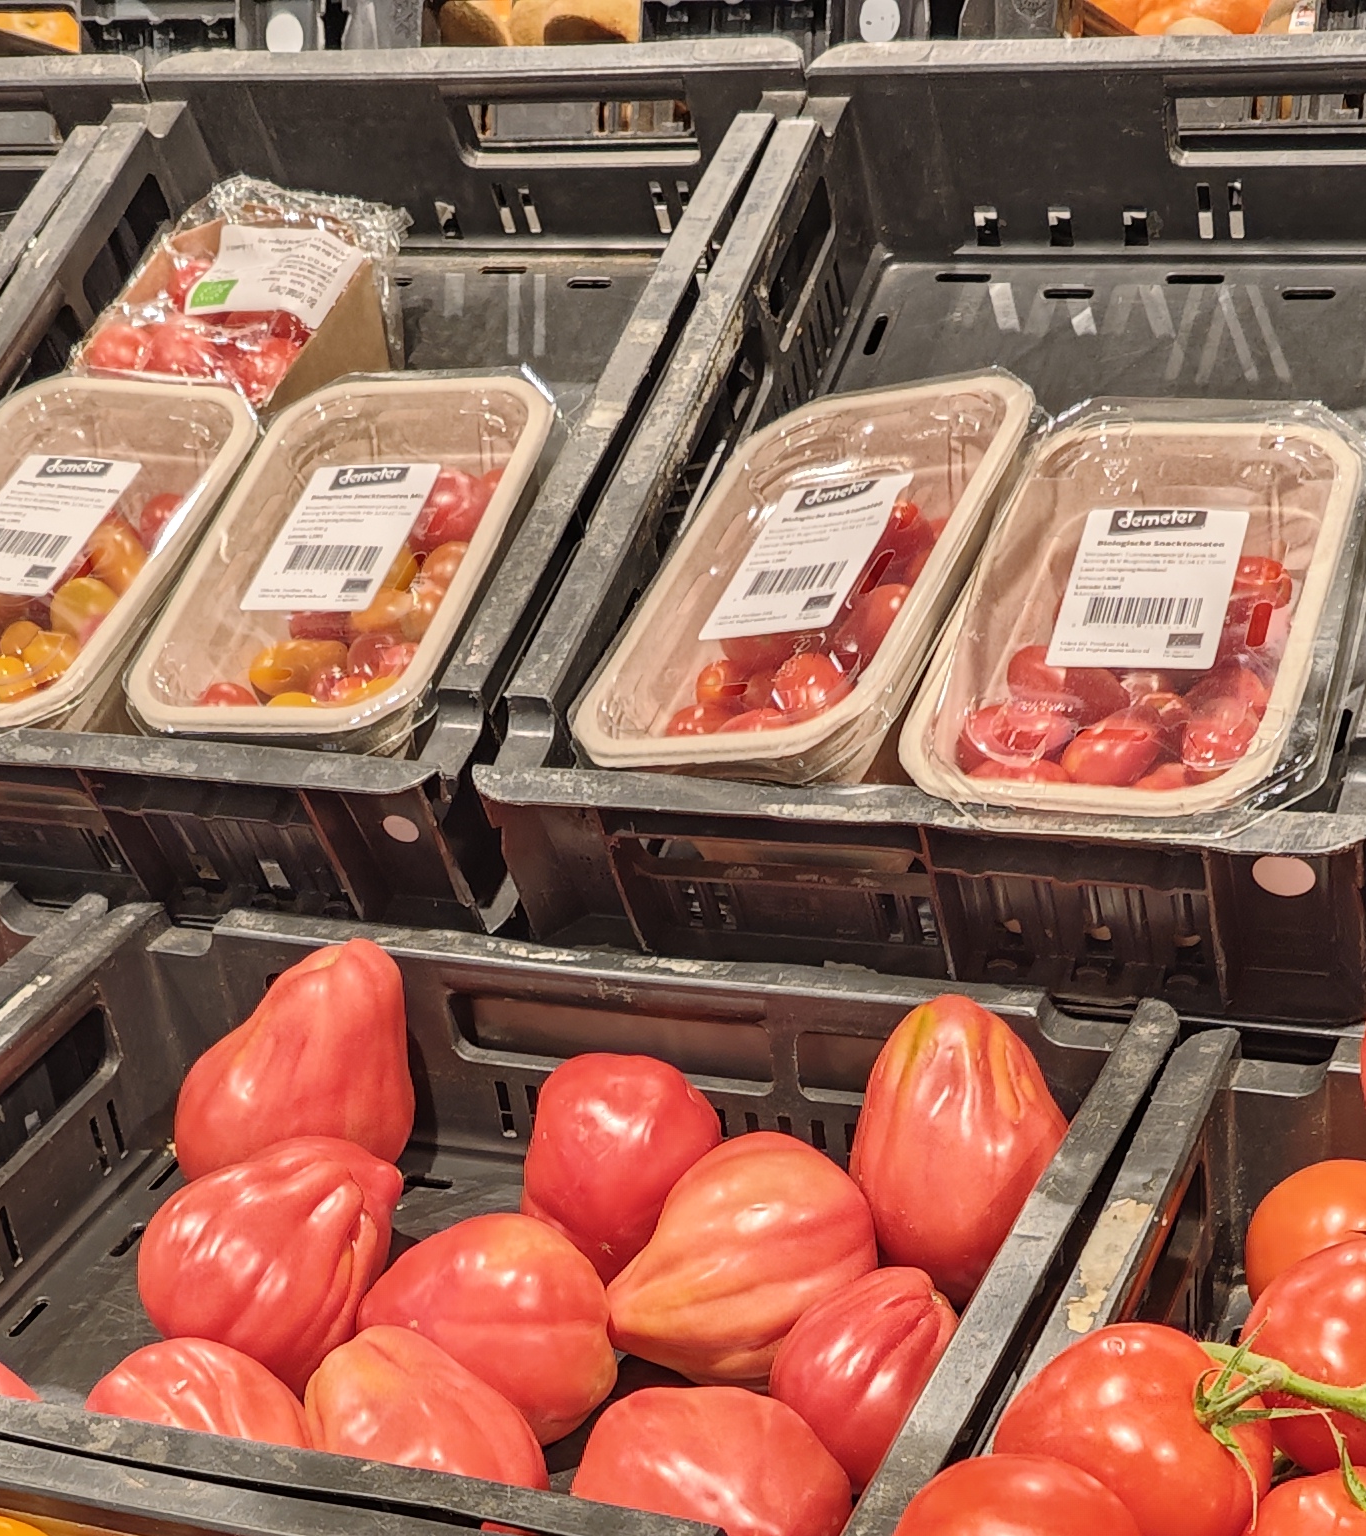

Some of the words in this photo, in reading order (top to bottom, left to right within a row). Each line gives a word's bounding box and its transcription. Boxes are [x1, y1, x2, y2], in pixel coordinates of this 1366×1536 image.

[45, 459, 105, 473] demeter
[338, 468, 402, 485] demeter
[804, 480, 871, 506] demeter
[1117, 510, 1196, 528] demeter
